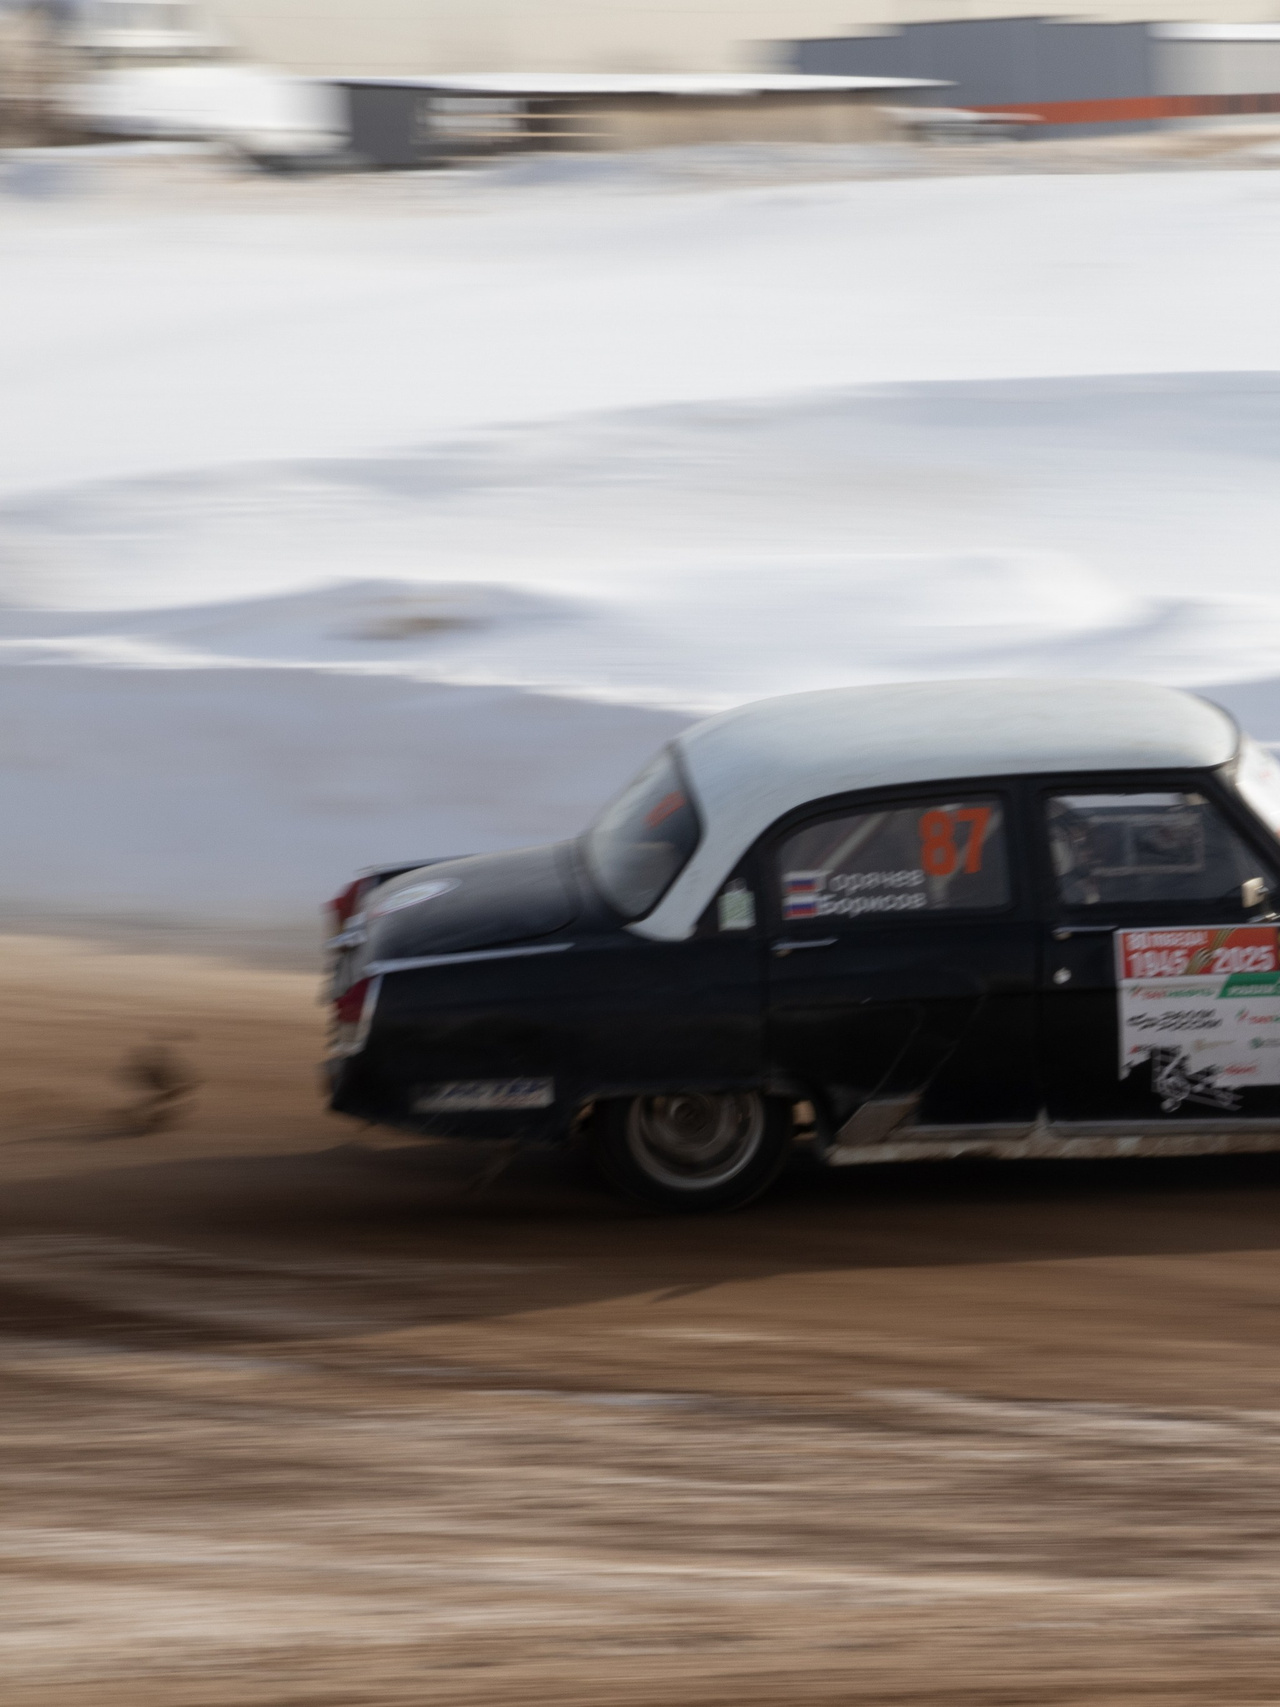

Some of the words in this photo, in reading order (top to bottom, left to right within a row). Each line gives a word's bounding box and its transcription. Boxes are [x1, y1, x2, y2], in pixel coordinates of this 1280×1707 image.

[918, 807, 991, 876] 87
[817, 893, 928, 918] Борисов
[1128, 950, 1189, 978] 1945
[1211, 945, 1276, 974] 2025
